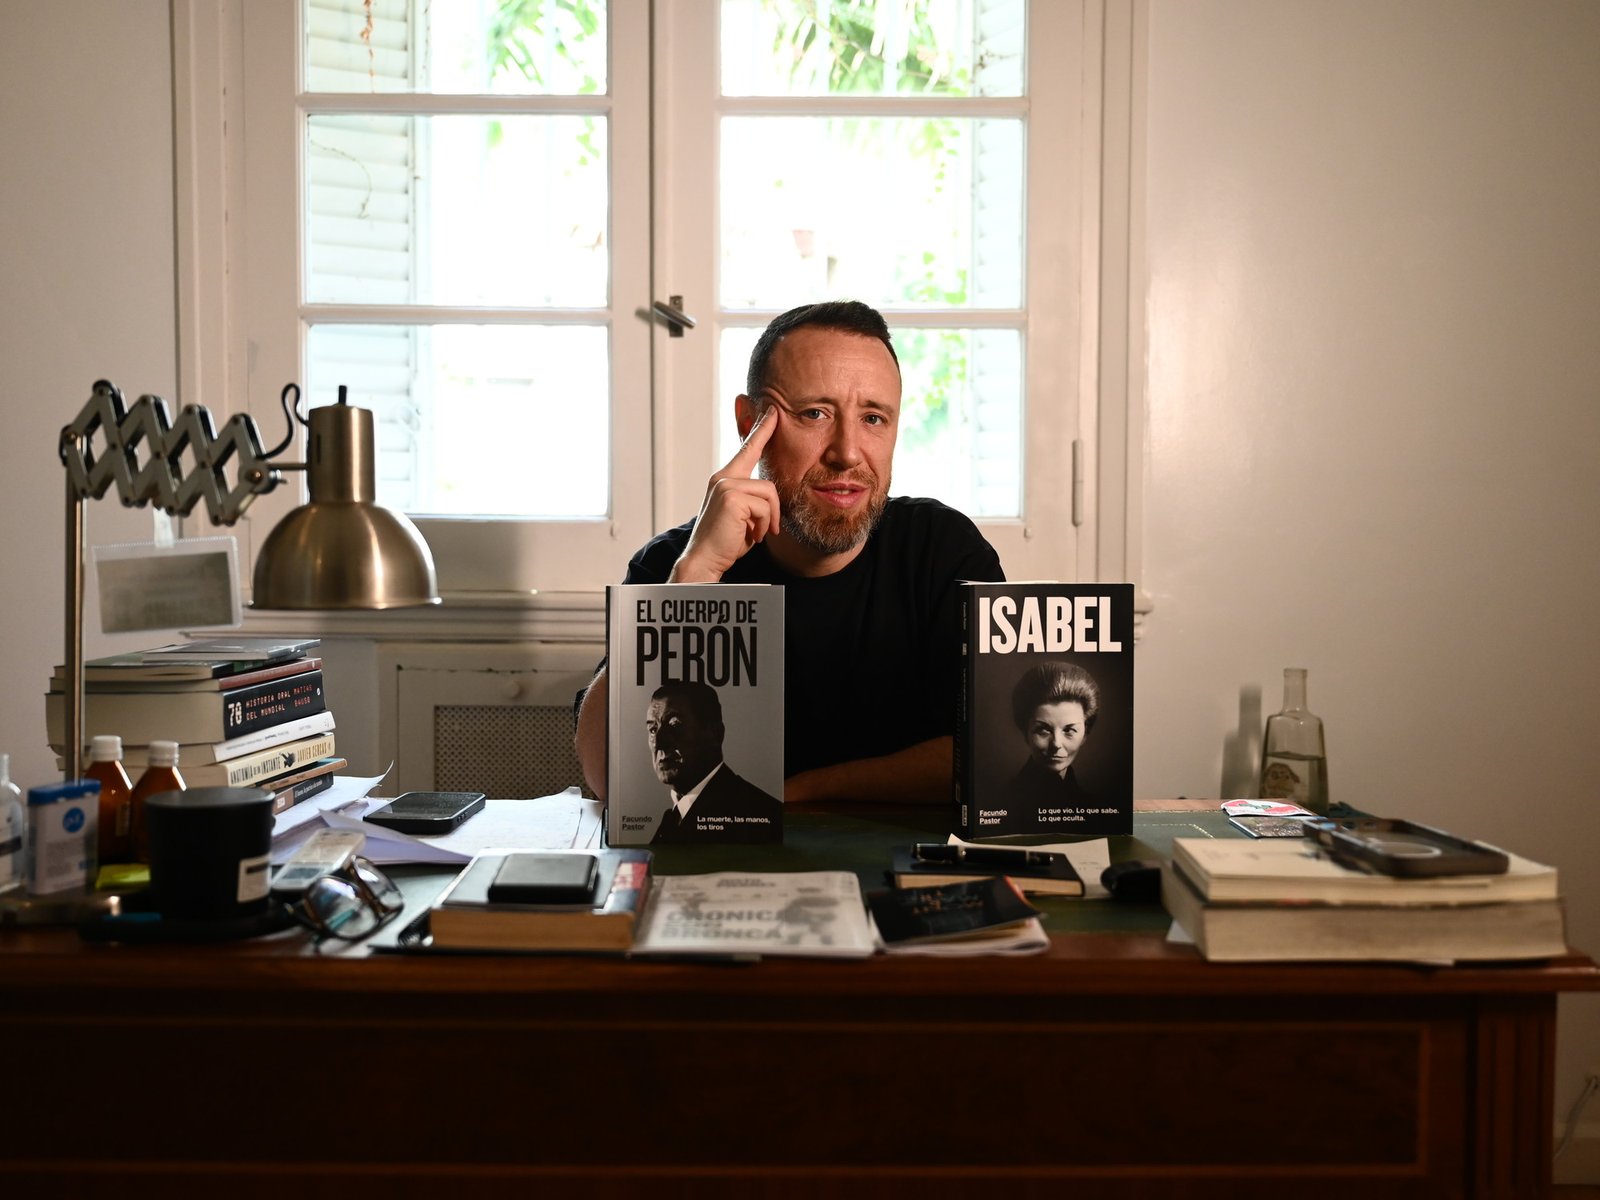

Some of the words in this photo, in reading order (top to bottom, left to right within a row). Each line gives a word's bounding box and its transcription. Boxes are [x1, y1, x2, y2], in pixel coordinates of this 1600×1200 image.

[636, 600, 656, 623] EL
[661, 600, 729, 624] CUERPO
[736, 600, 758, 624] DE
[979, 596, 1122, 654] ISABEL
[636, 615, 758, 687] PERÓN
[245, 694, 275, 709] HISTORIA
[277, 690, 291, 700] ORAL
[228, 701, 243, 727] 78
[245, 710, 258, 721] DEL
[260, 704, 286, 717] MUNDIAL
[622, 815, 653, 823] Facundo
[697, 815, 706, 823] La
[980, 809, 1008, 817] Facundo
[980, 817, 1001, 825] Pastor
[622, 823, 646, 831] Pastor
